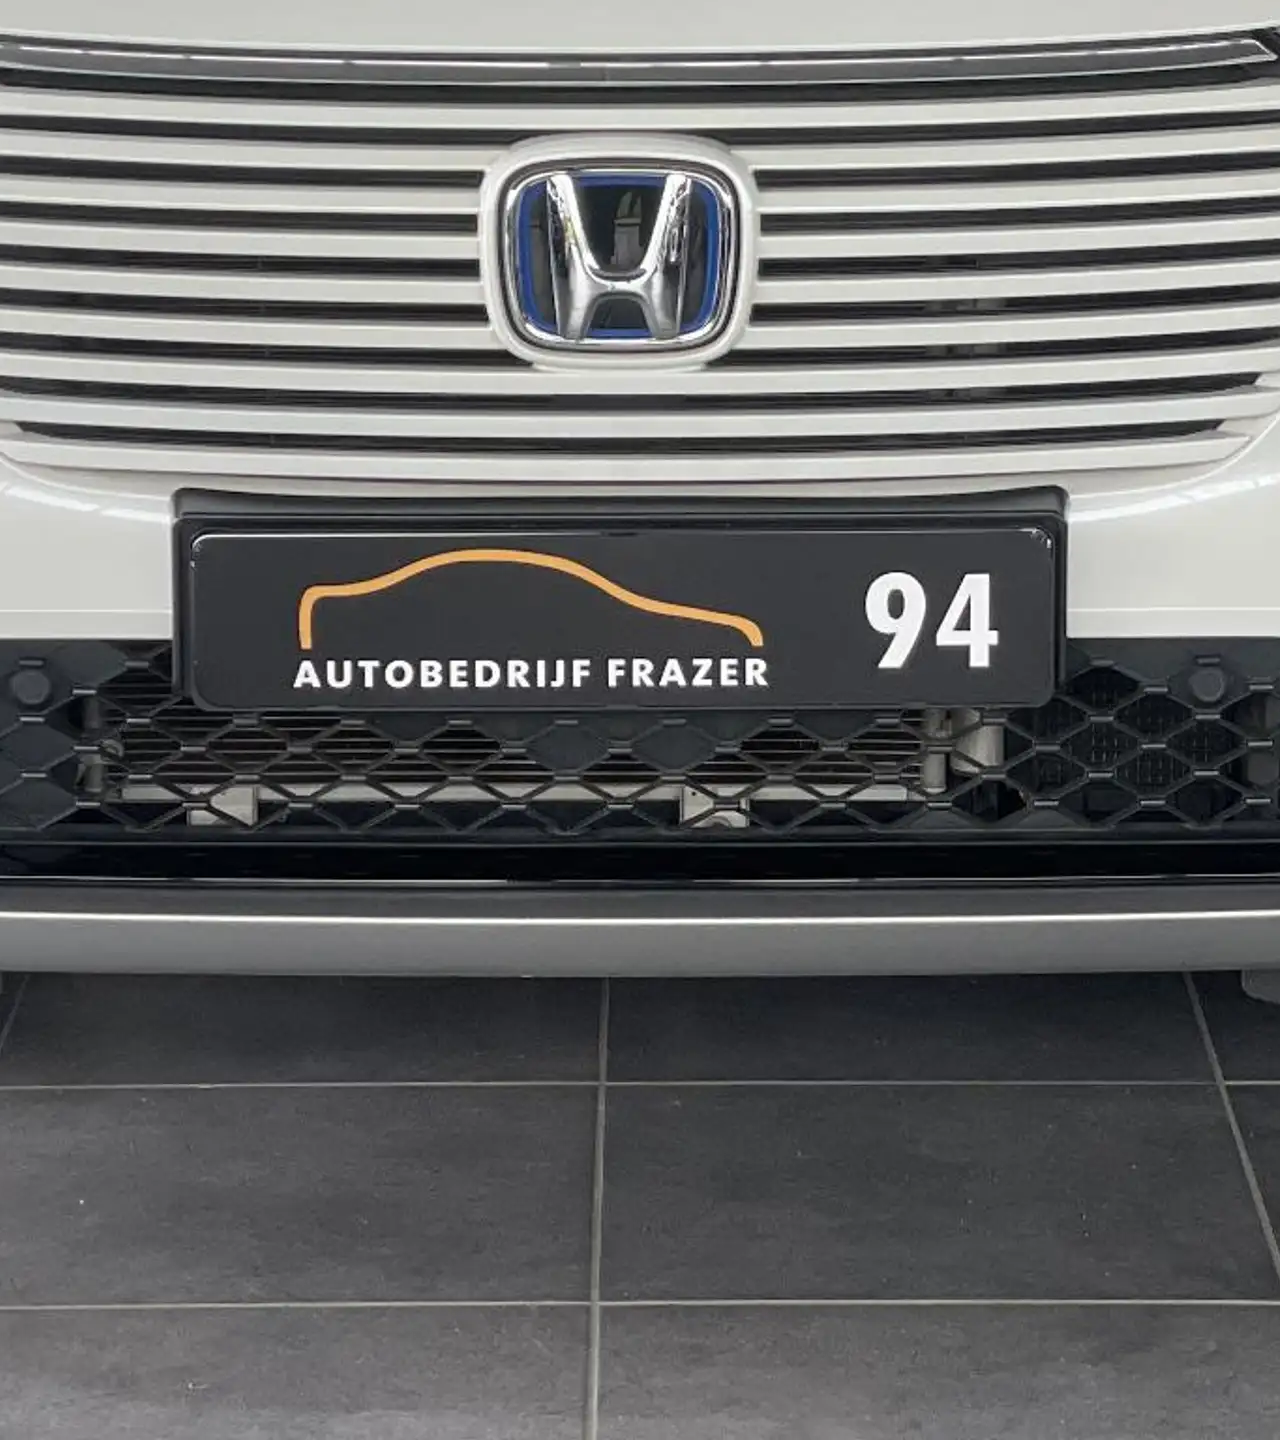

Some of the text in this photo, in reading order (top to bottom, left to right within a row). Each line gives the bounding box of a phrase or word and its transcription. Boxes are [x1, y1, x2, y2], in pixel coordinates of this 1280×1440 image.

[865, 571, 999, 669] 94
[293, 658, 769, 689] AUTOBEDRIJF FRAZER
